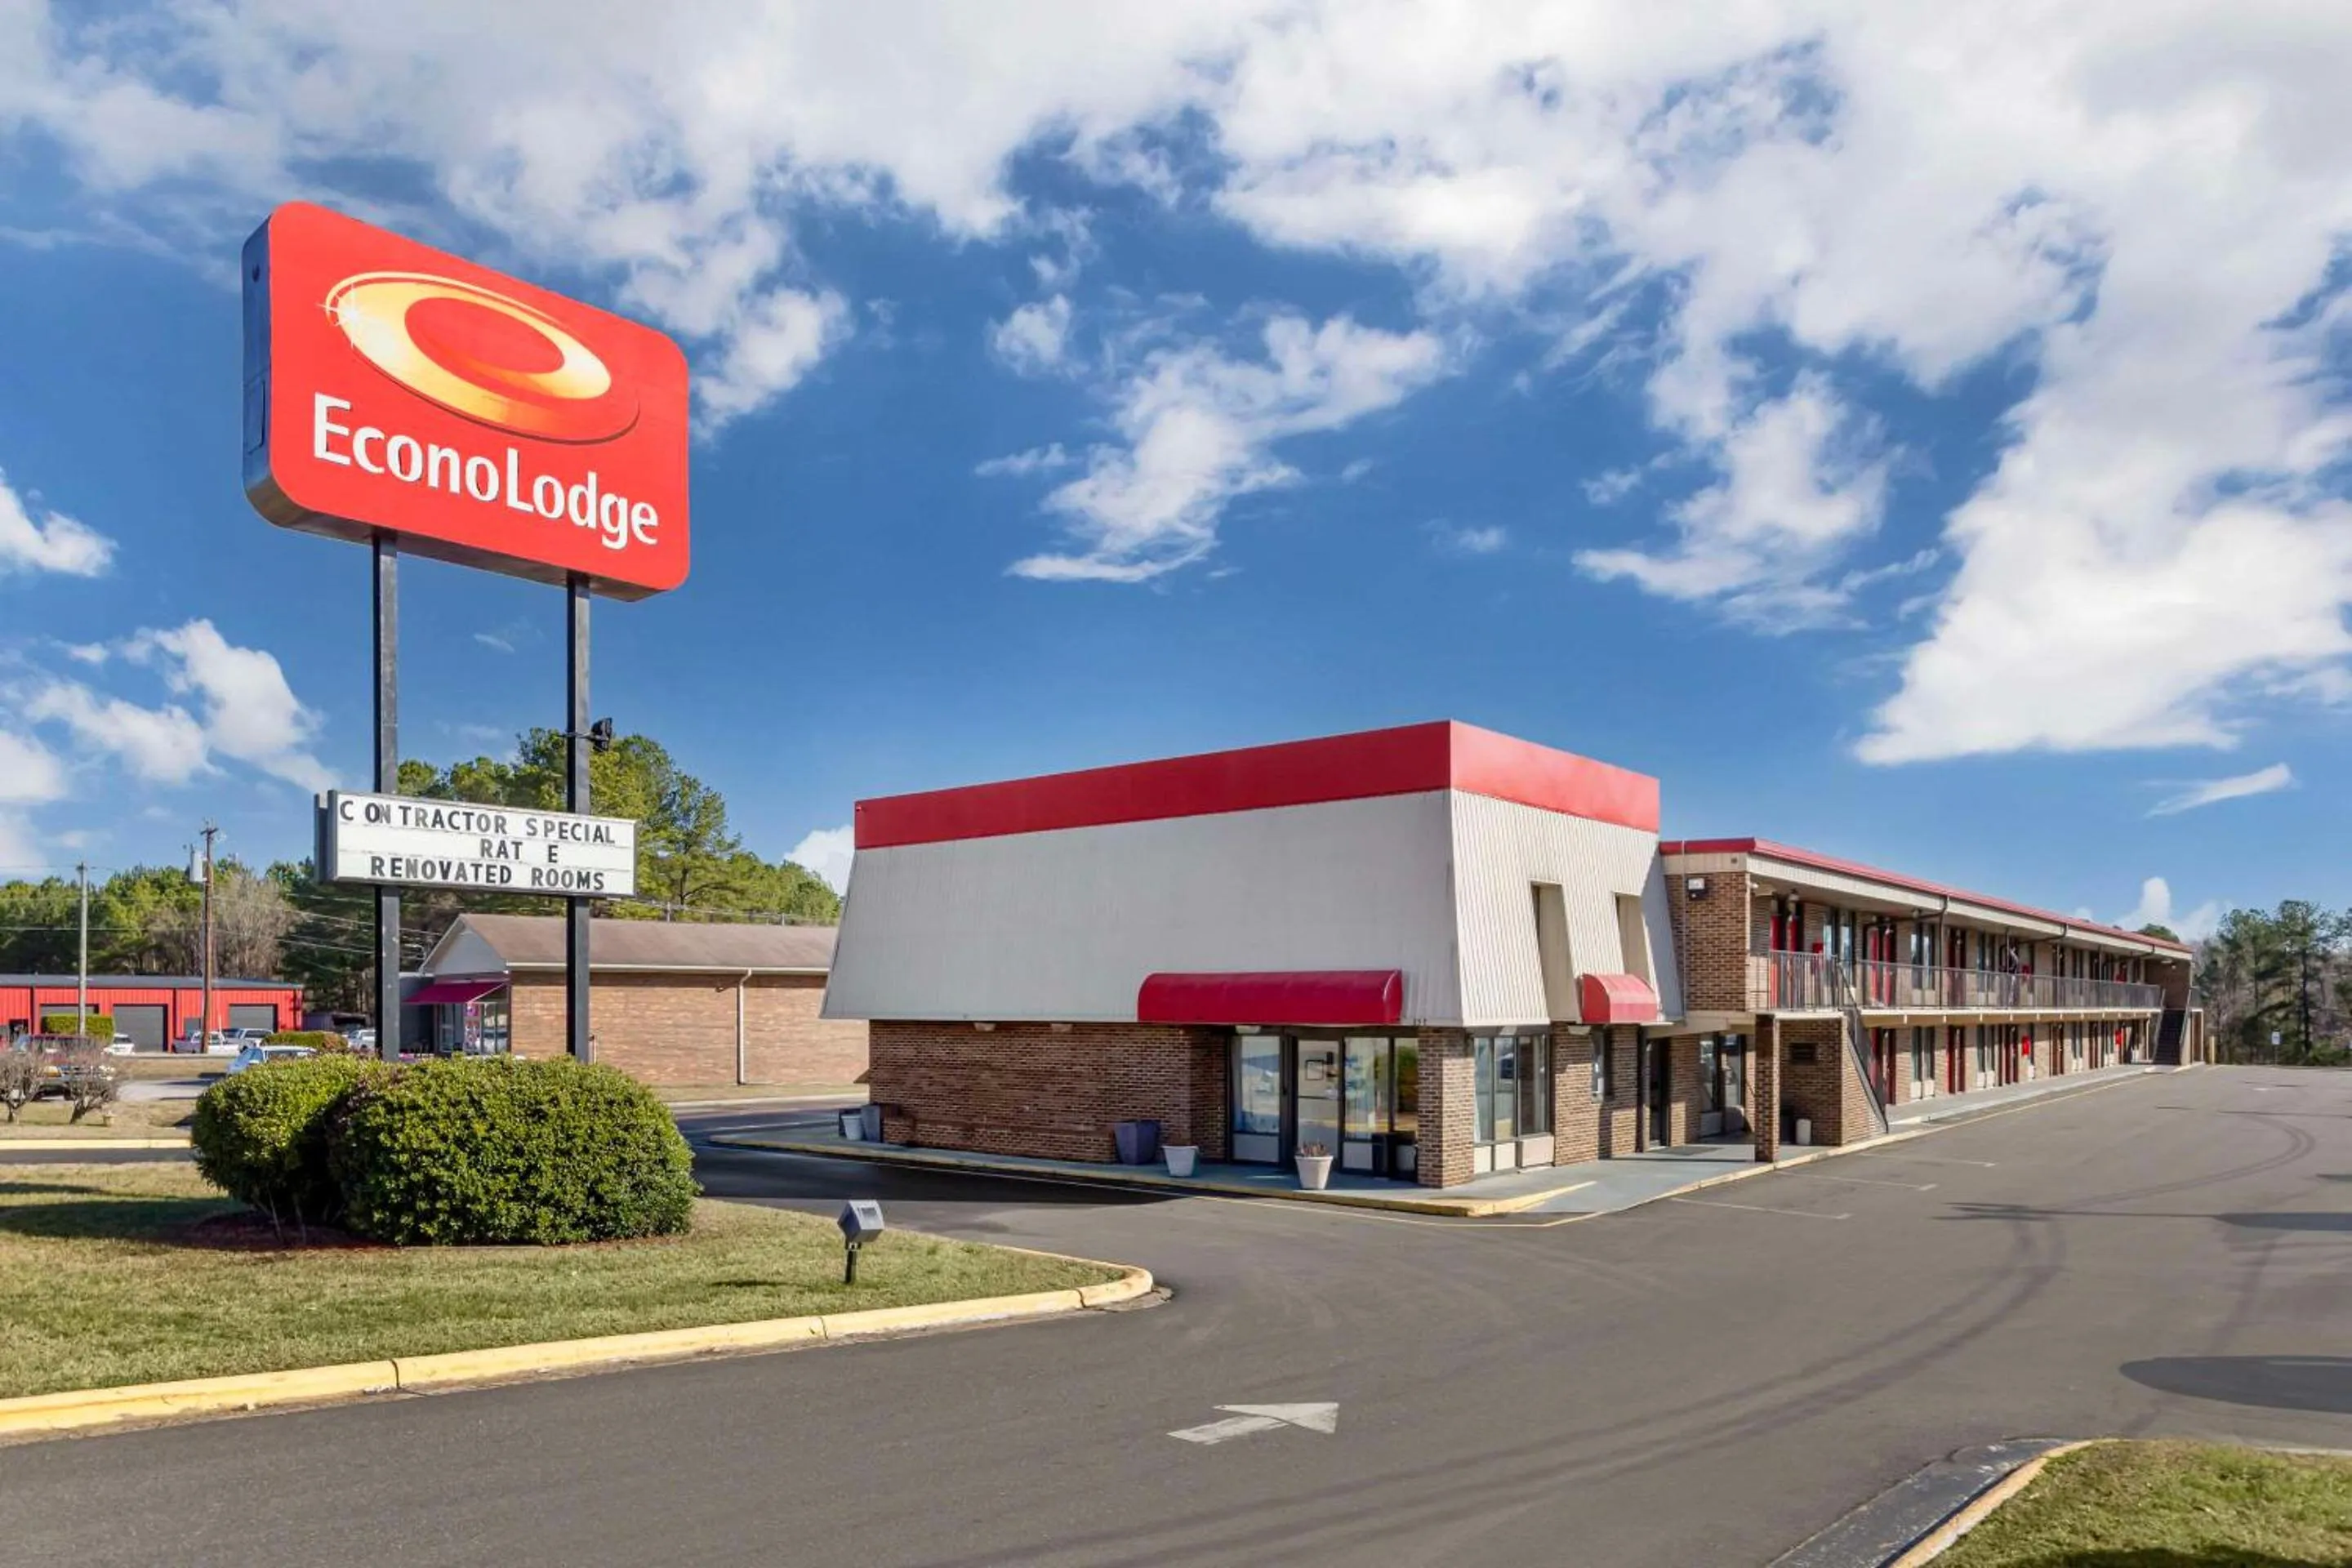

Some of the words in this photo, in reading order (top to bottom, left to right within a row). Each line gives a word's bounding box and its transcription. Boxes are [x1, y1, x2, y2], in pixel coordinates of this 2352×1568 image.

[314, 392, 659, 550] EconoLodge
[339, 800, 508, 835] CONTRACTOR
[525, 817, 616, 844] SPECIAL
[370, 855, 512, 885] RENOVATED
[531, 866, 605, 891] ROOMS
